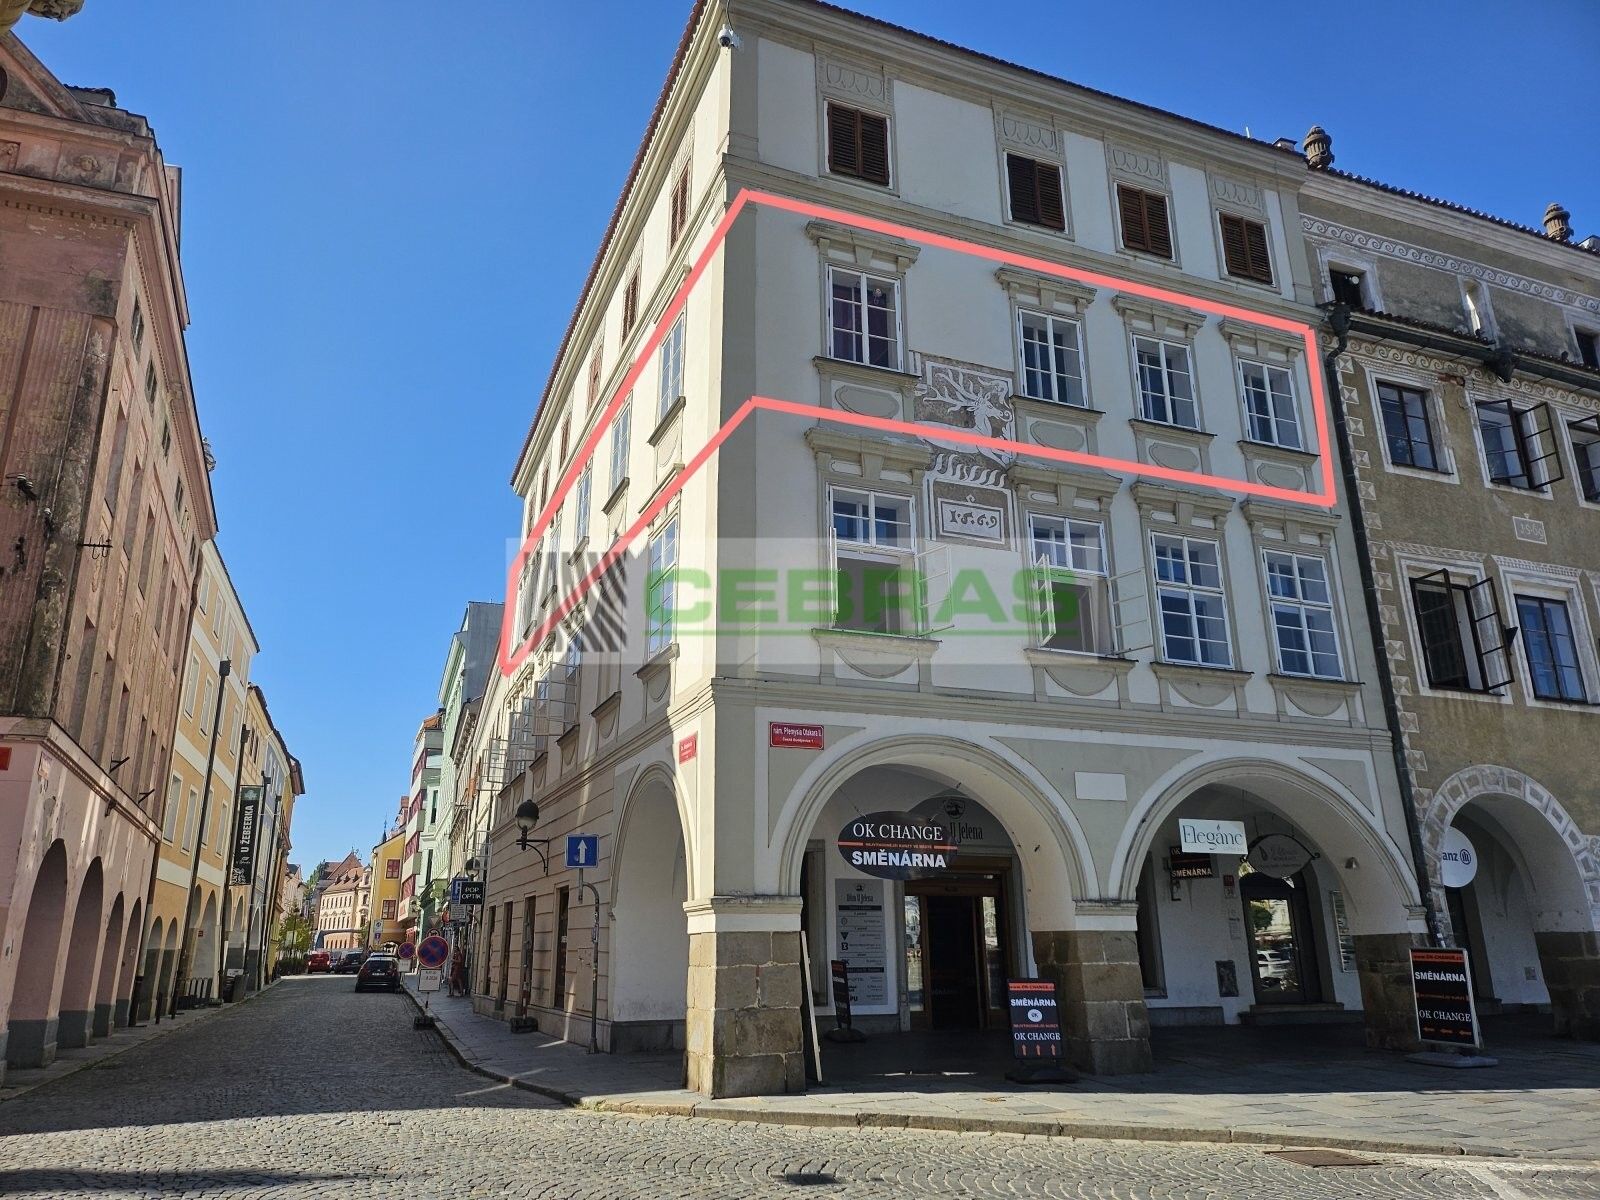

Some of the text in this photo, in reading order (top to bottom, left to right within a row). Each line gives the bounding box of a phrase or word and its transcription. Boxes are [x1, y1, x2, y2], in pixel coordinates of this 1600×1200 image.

[853, 823, 943, 841] OK CHANGE
[957, 822, 984, 843] Jelena
[852, 849, 946, 868] SMĚNÁRNA
[1442, 852, 1458, 861] anz
[1171, 867, 1213, 878] SMĚNÁRNA
[1414, 970, 1466, 982] SMĚNÁRNA
[1010, 998, 1057, 1007] SMĚNÁRNA
[1419, 1009, 1472, 1022] OK CHANGE
[1014, 1032, 1061, 1041] OK CHANGE
